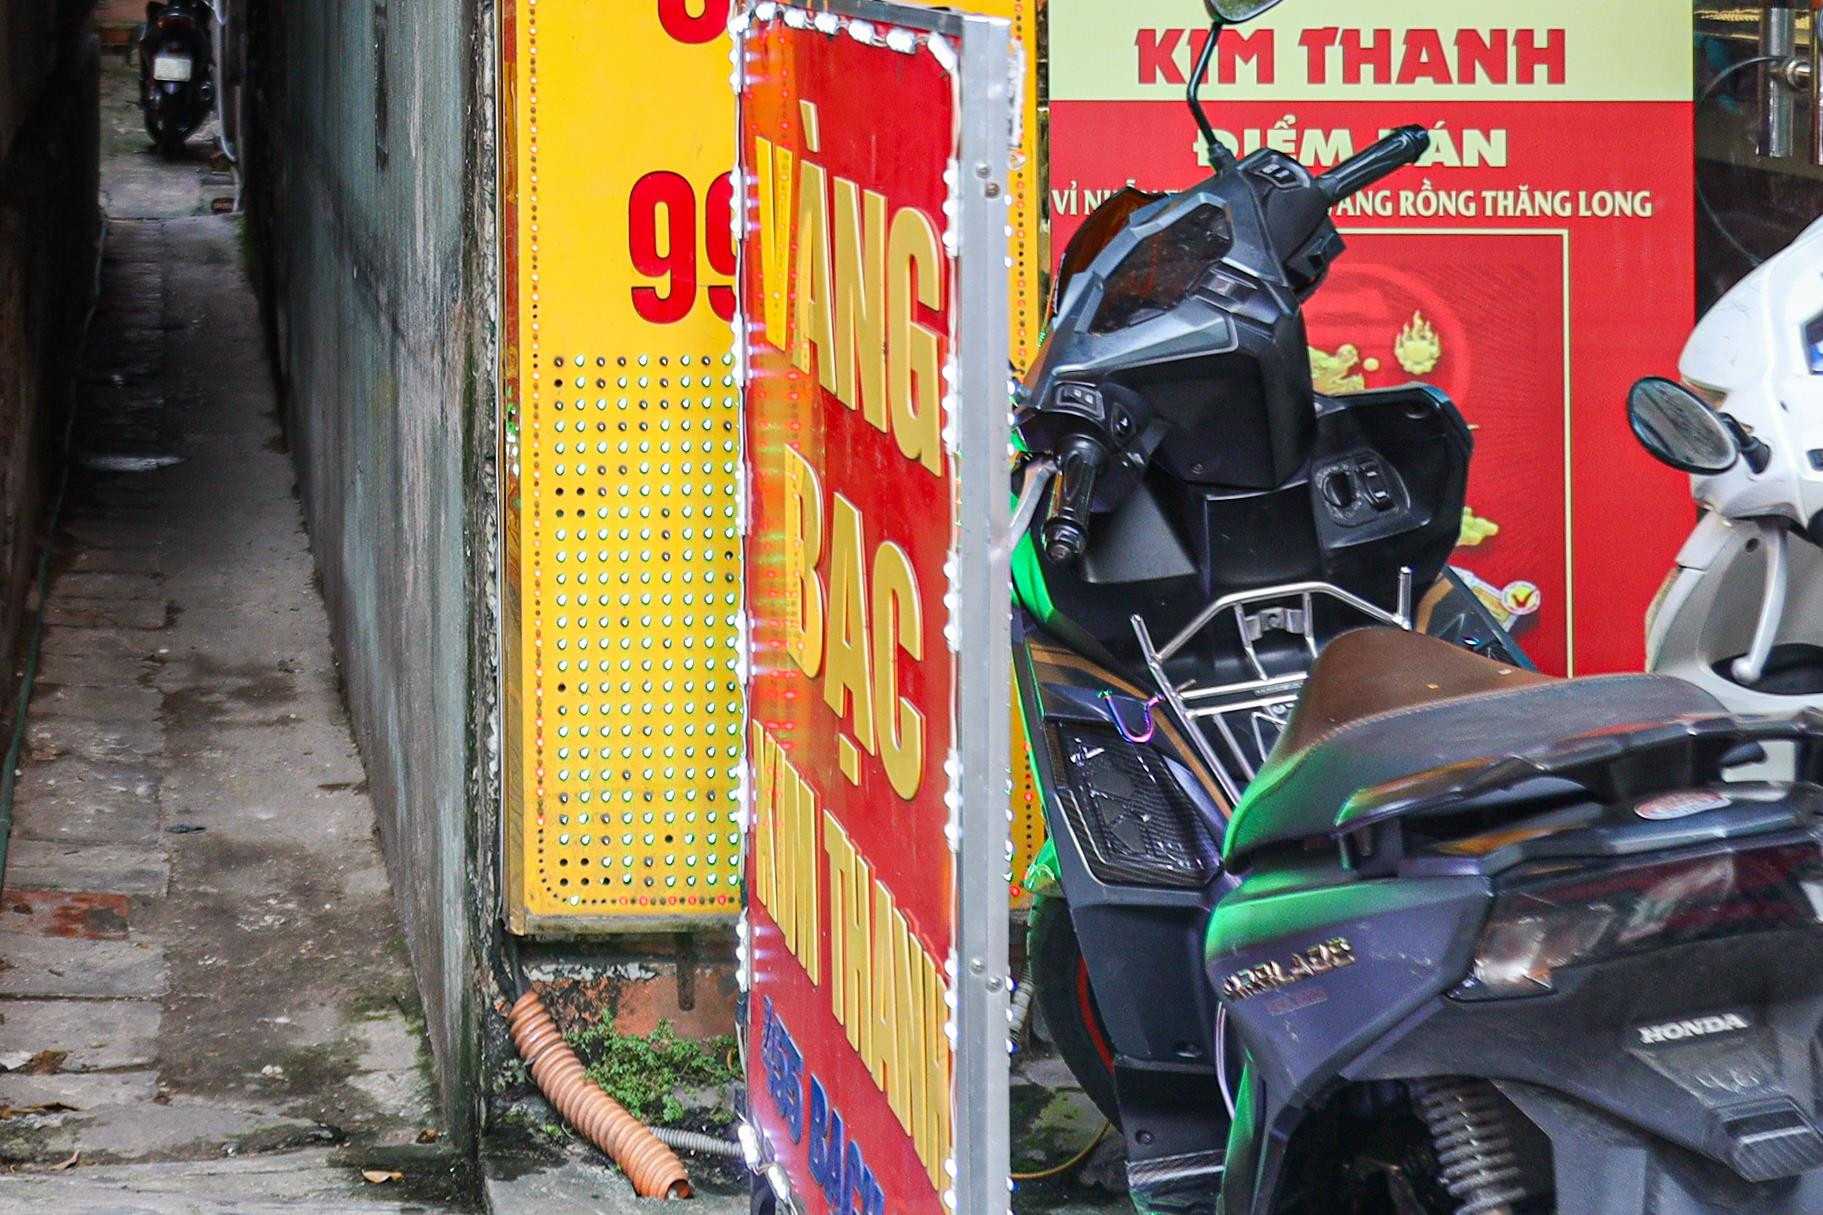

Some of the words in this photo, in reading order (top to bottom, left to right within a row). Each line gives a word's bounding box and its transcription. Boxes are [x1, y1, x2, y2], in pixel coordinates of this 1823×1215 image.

[1297, 27, 1567, 86] THANH
[1051, 180, 1078, 216] VỈ
[1399, 174, 1477, 218] RỒNG
[1483, 186, 1574, 218] THĂNG
[1578, 190, 1653, 218] LONG
[755, 99, 944, 477] VÀNG
[783, 445, 925, 802] BẠC
[1637, 1012, 1751, 1045] HONDA
